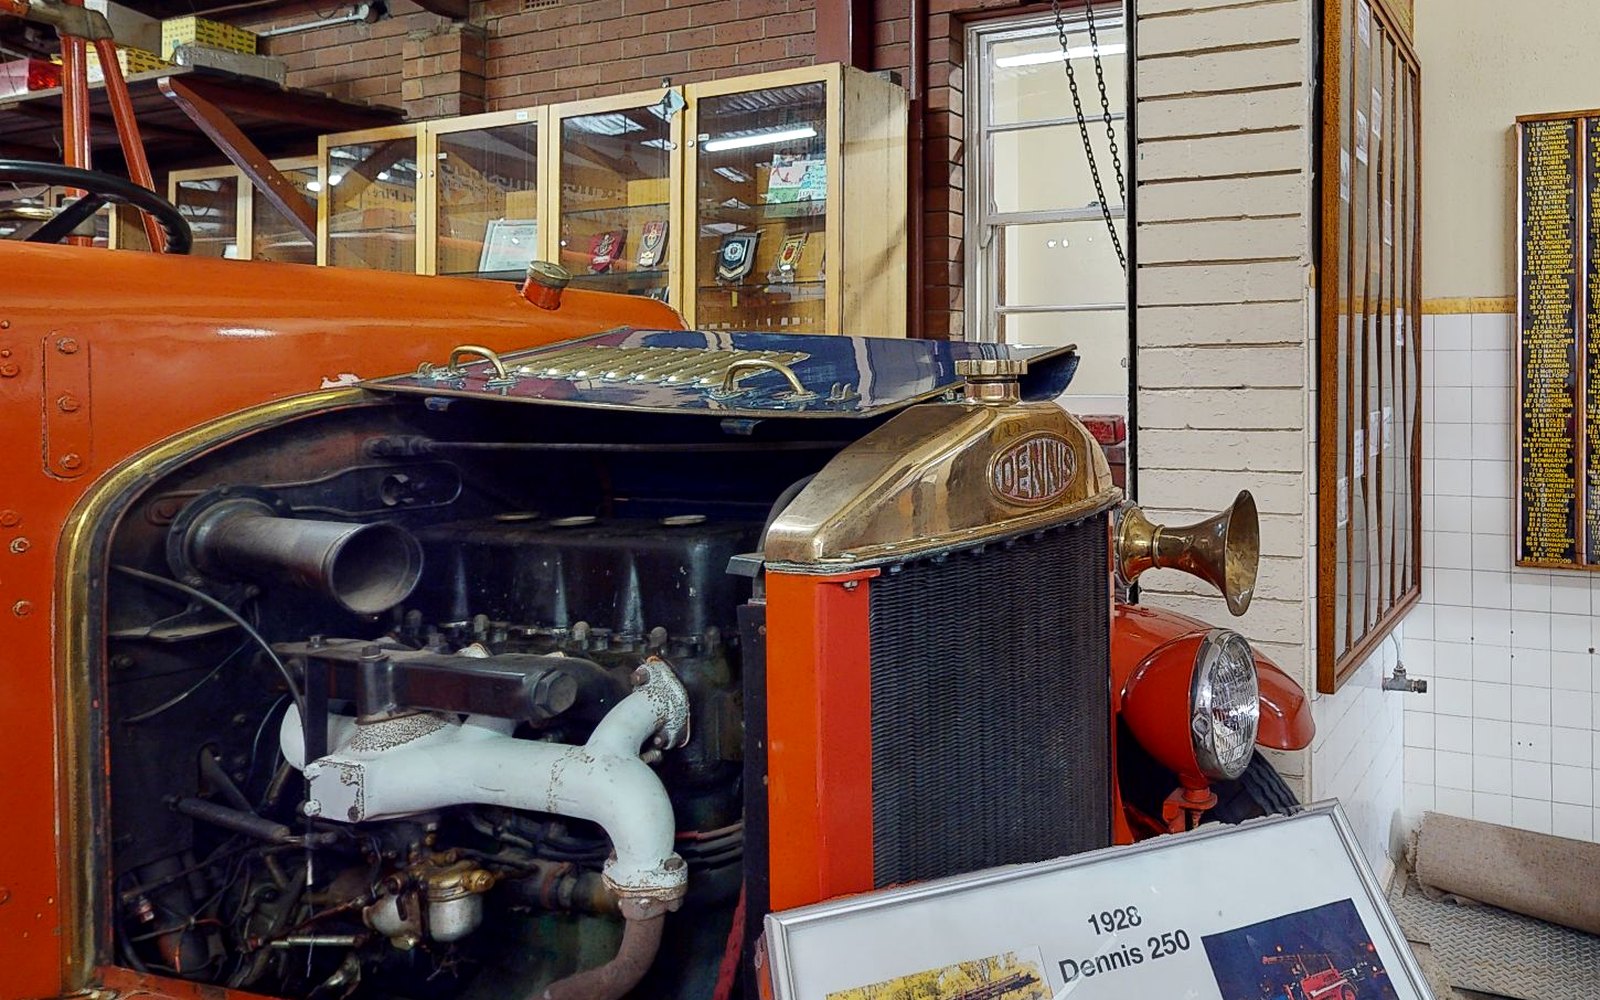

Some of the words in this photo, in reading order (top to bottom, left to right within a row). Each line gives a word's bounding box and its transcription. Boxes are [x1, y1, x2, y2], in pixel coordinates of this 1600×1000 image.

[1001, 438, 1075, 498] DENNIS
[1088, 905, 1142, 935] 1928
[1058, 944, 1144, 984] Dennis
[1147, 929, 1190, 960] 250
